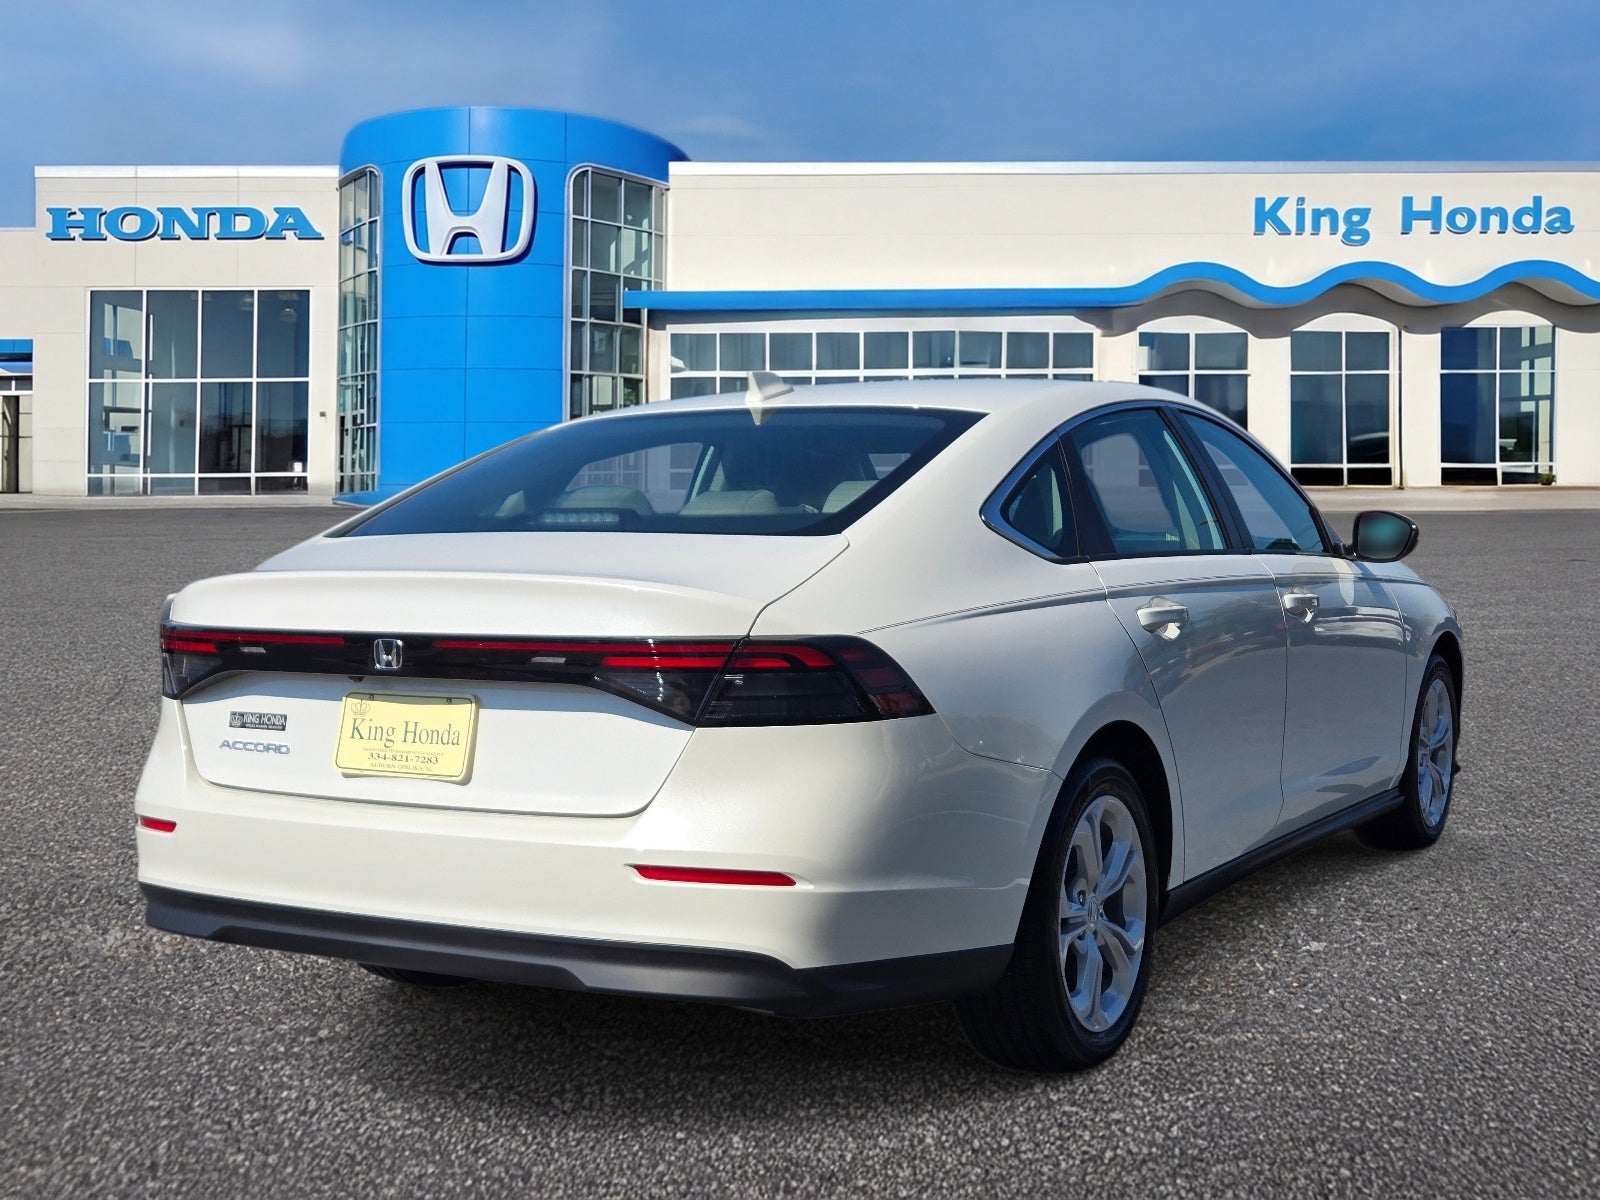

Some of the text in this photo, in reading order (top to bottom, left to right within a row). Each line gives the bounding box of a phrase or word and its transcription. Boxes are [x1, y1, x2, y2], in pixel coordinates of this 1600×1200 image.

[46, 206, 325, 241] HONDA
[1253, 195, 1575, 246] King Honda
[243, 712, 286, 726] KING HONDA
[349, 717, 461, 748] King Honda
[219, 739, 290, 754] ACCORD
[367, 752, 439, 764] 334-821-7283
